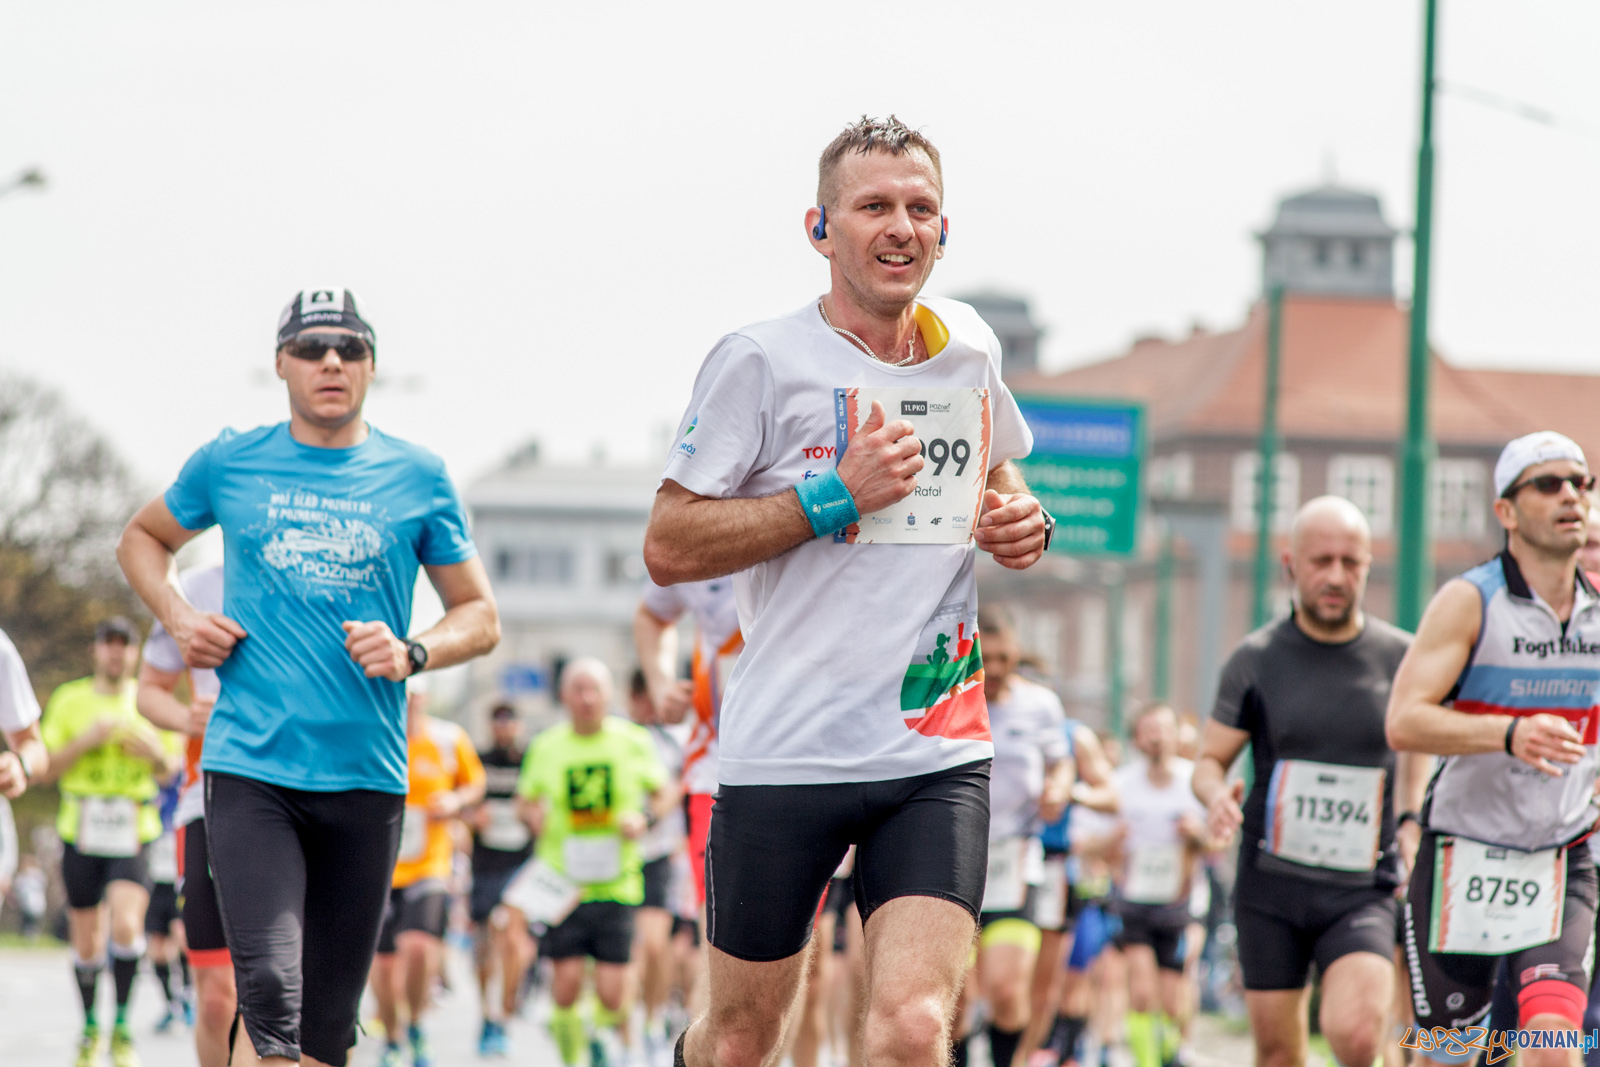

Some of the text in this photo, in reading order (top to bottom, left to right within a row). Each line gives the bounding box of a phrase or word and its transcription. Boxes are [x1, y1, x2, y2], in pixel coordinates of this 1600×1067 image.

[912, 404, 926, 412] PKO
[839, 423, 847, 431] C
[802, 446, 837, 459] TOY
[914, 485, 942, 497] Rafał
[930, 517, 943, 525] 4F
[1513, 636, 1556, 658] Fogt
[1294, 794, 1370, 825] 11394
[1466, 875, 1540, 907] 8759
